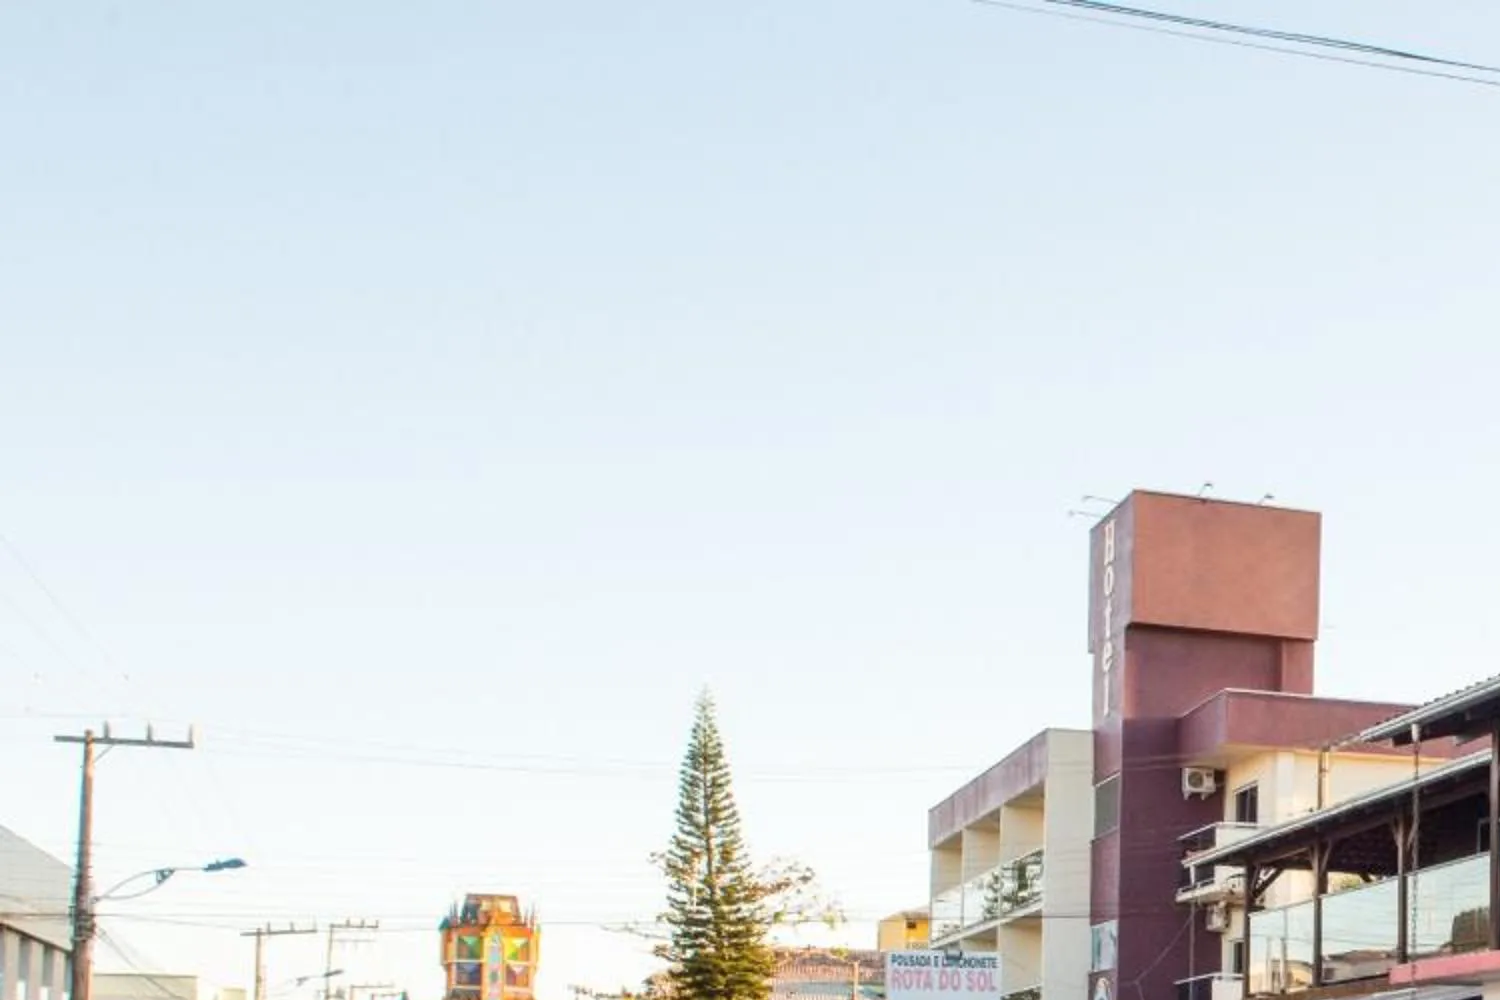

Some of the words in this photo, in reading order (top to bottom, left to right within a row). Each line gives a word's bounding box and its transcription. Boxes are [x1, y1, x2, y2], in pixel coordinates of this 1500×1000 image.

[1103, 519, 1117, 717] Hotel
[892, 969, 932, 991] ROTA
[938, 969, 961, 992] DO
[966, 970, 998, 992] SOL
